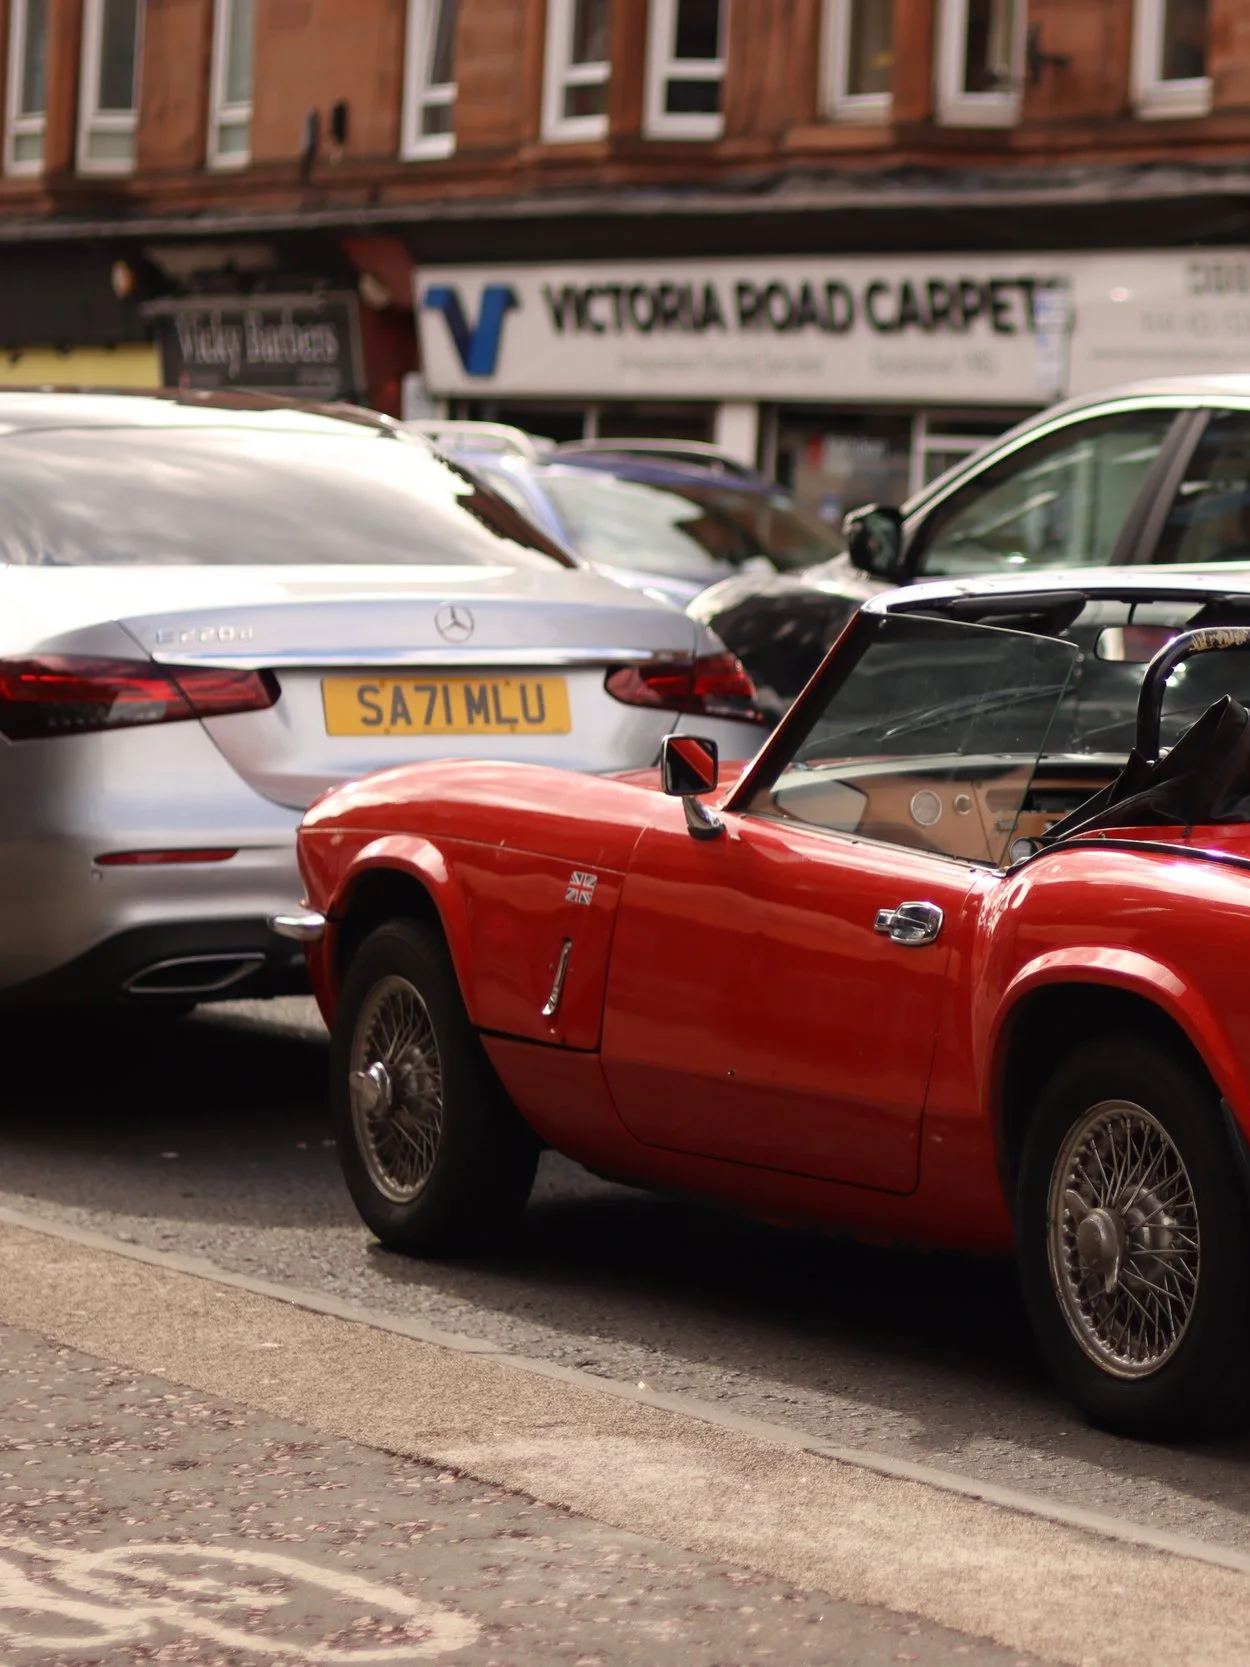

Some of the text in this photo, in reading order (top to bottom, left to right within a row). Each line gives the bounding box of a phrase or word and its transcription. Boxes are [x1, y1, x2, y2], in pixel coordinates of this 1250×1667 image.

[543, 275, 1072, 335] VICTORIA ROAD CARPET
[357, 684, 546, 726] SA71 MLU
